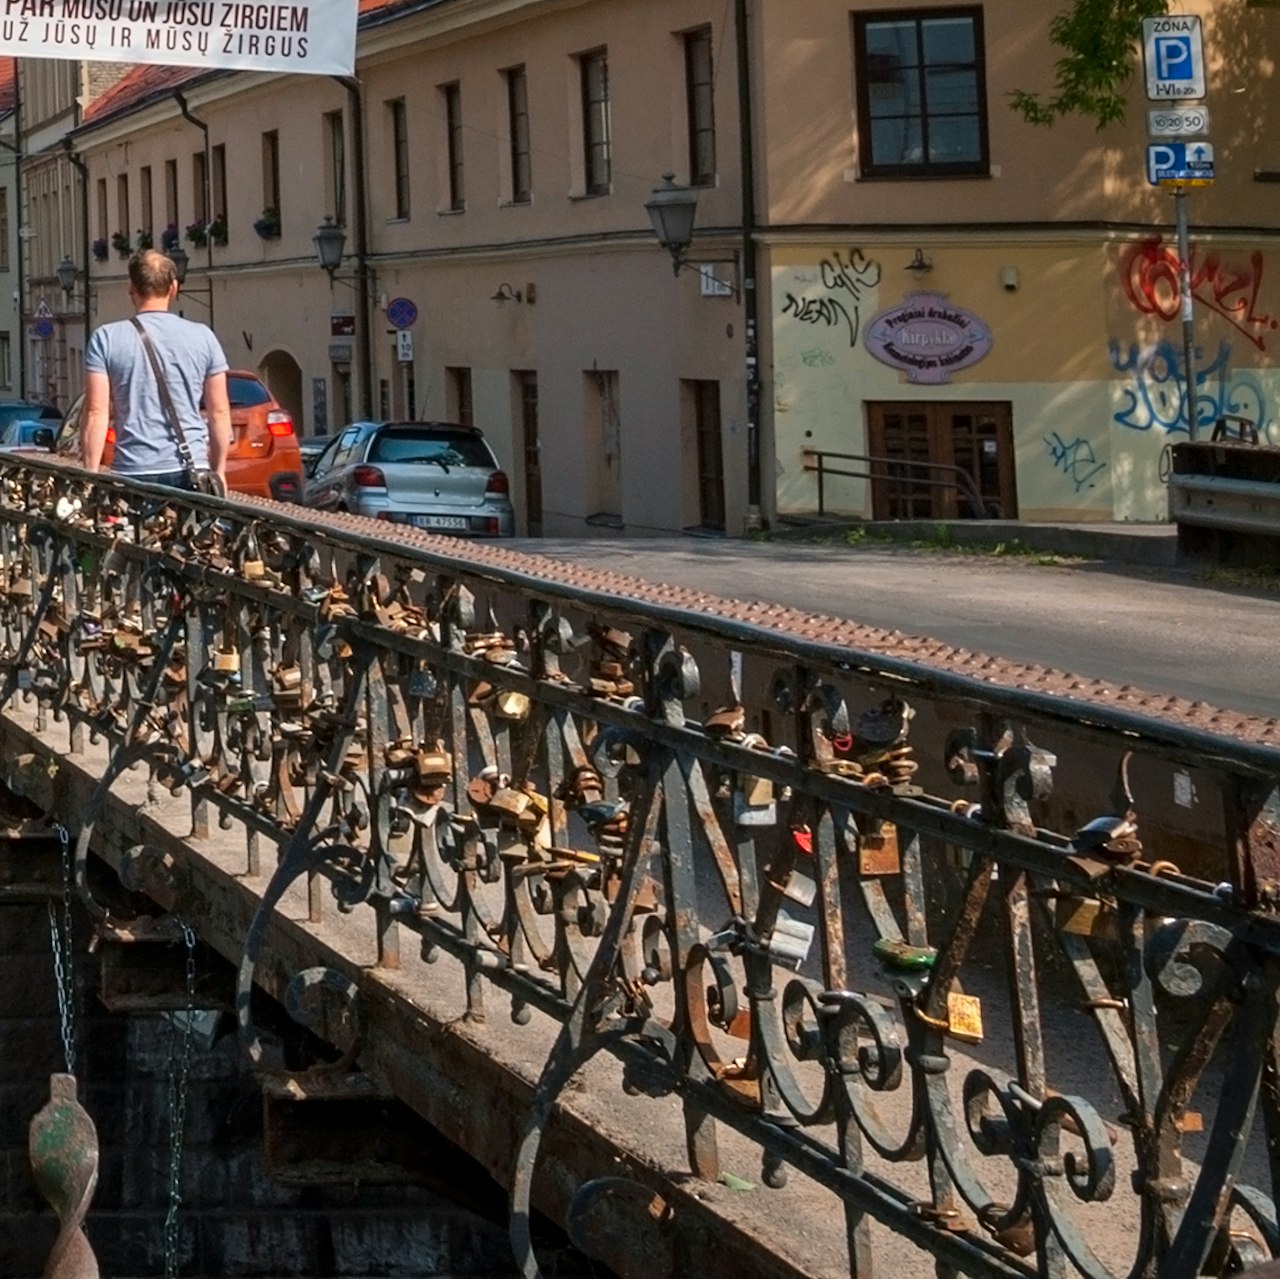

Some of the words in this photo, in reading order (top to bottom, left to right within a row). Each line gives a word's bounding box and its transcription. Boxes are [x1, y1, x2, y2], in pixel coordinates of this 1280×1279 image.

[128, 0, 158, 24] UN
[220, 3, 309, 32] ZIRGIEM
[1154, 21, 1190, 33] ZONA
[3, 16, 28, 42] UŽ
[111, 26, 131, 48] IR
[223, 28, 309, 58] ŽIRGUS
[1159, 39, 1188, 78] P
[1185, 116, 1201, 127] 50
[1149, 146, 1175, 183] P
